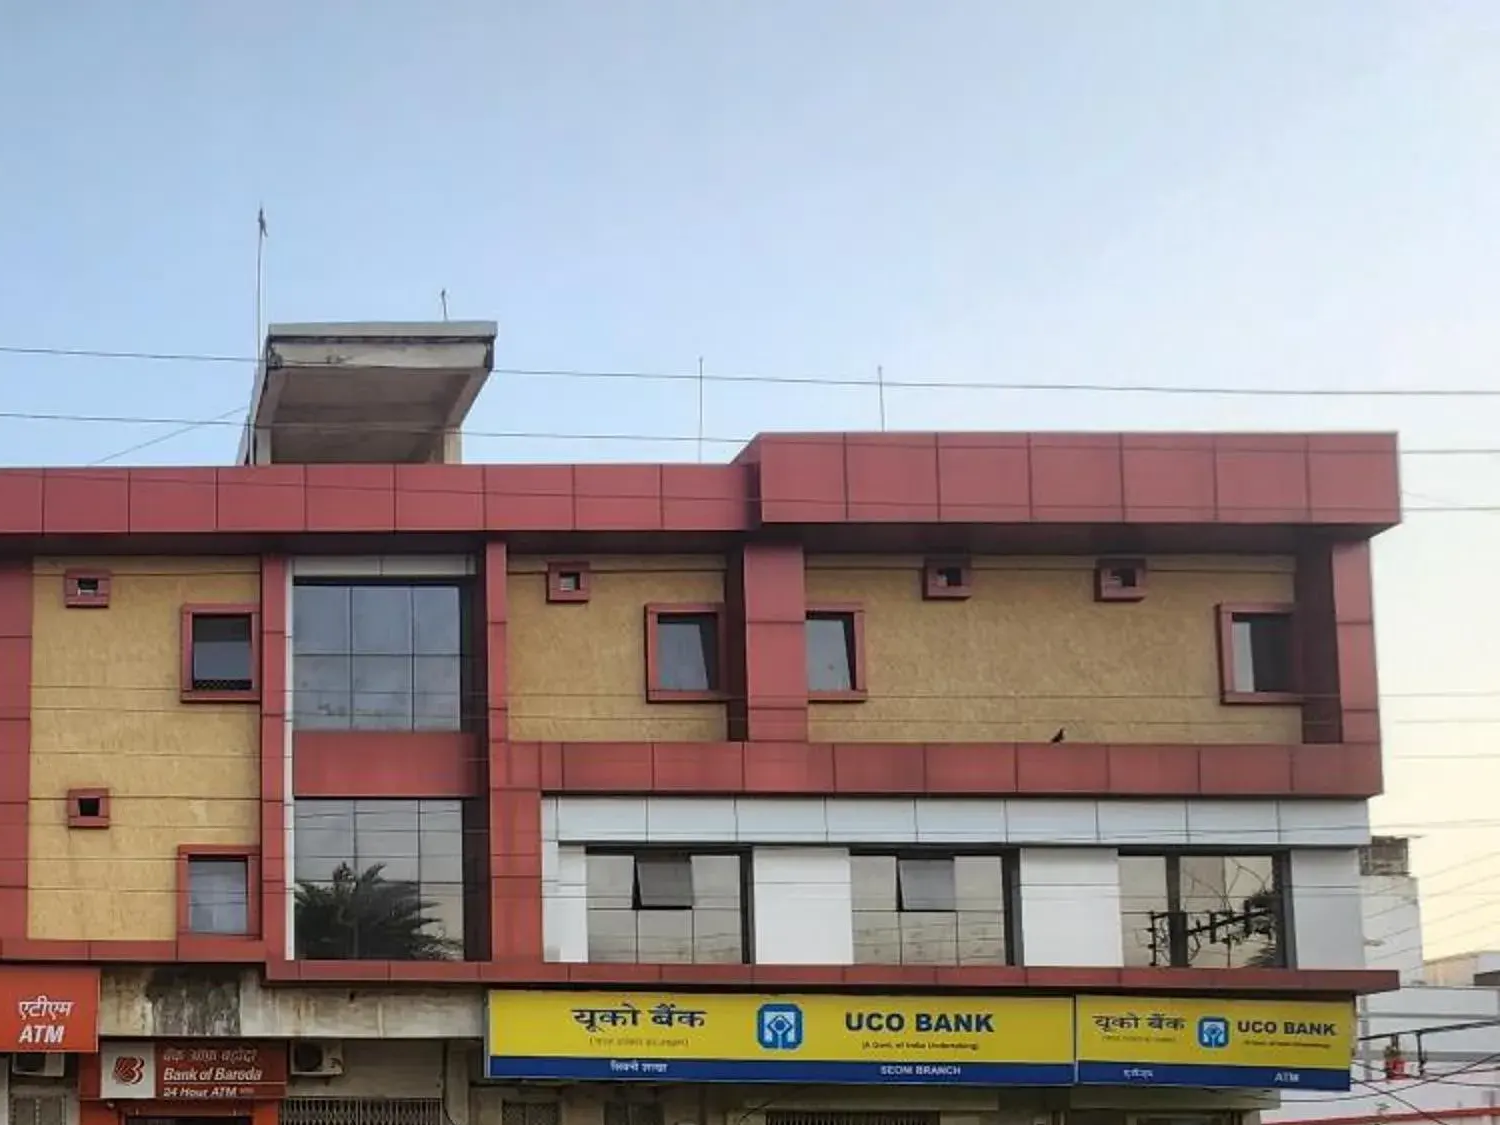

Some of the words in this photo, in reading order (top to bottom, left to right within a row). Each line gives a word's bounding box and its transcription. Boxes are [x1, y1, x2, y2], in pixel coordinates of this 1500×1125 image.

[19, 996, 73, 1018] एटीएम
[571, 1002, 642, 1032] यूको
[647, 1003, 708, 1028] बैंक
[845, 1012, 905, 1032] UCO
[915, 1013, 994, 1032] BANK
[1092, 1012, 1141, 1032] यूको
[1147, 1013, 1187, 1030] बैंक
[19, 1025, 65, 1043] ATM
[1238, 1021, 1277, 1034] UCO
[1283, 1022, 1336, 1036] BANK
[163, 1067, 199, 1081] Bank
[199, 1067, 214, 1081] of
[215, 1067, 263, 1081] Baroda
[915, 1065, 962, 1076] BRANCH
[163, 1087, 179, 1097] 24
[180, 1087, 209, 1097] Hour
[211, 1086, 238, 1097] ATM
